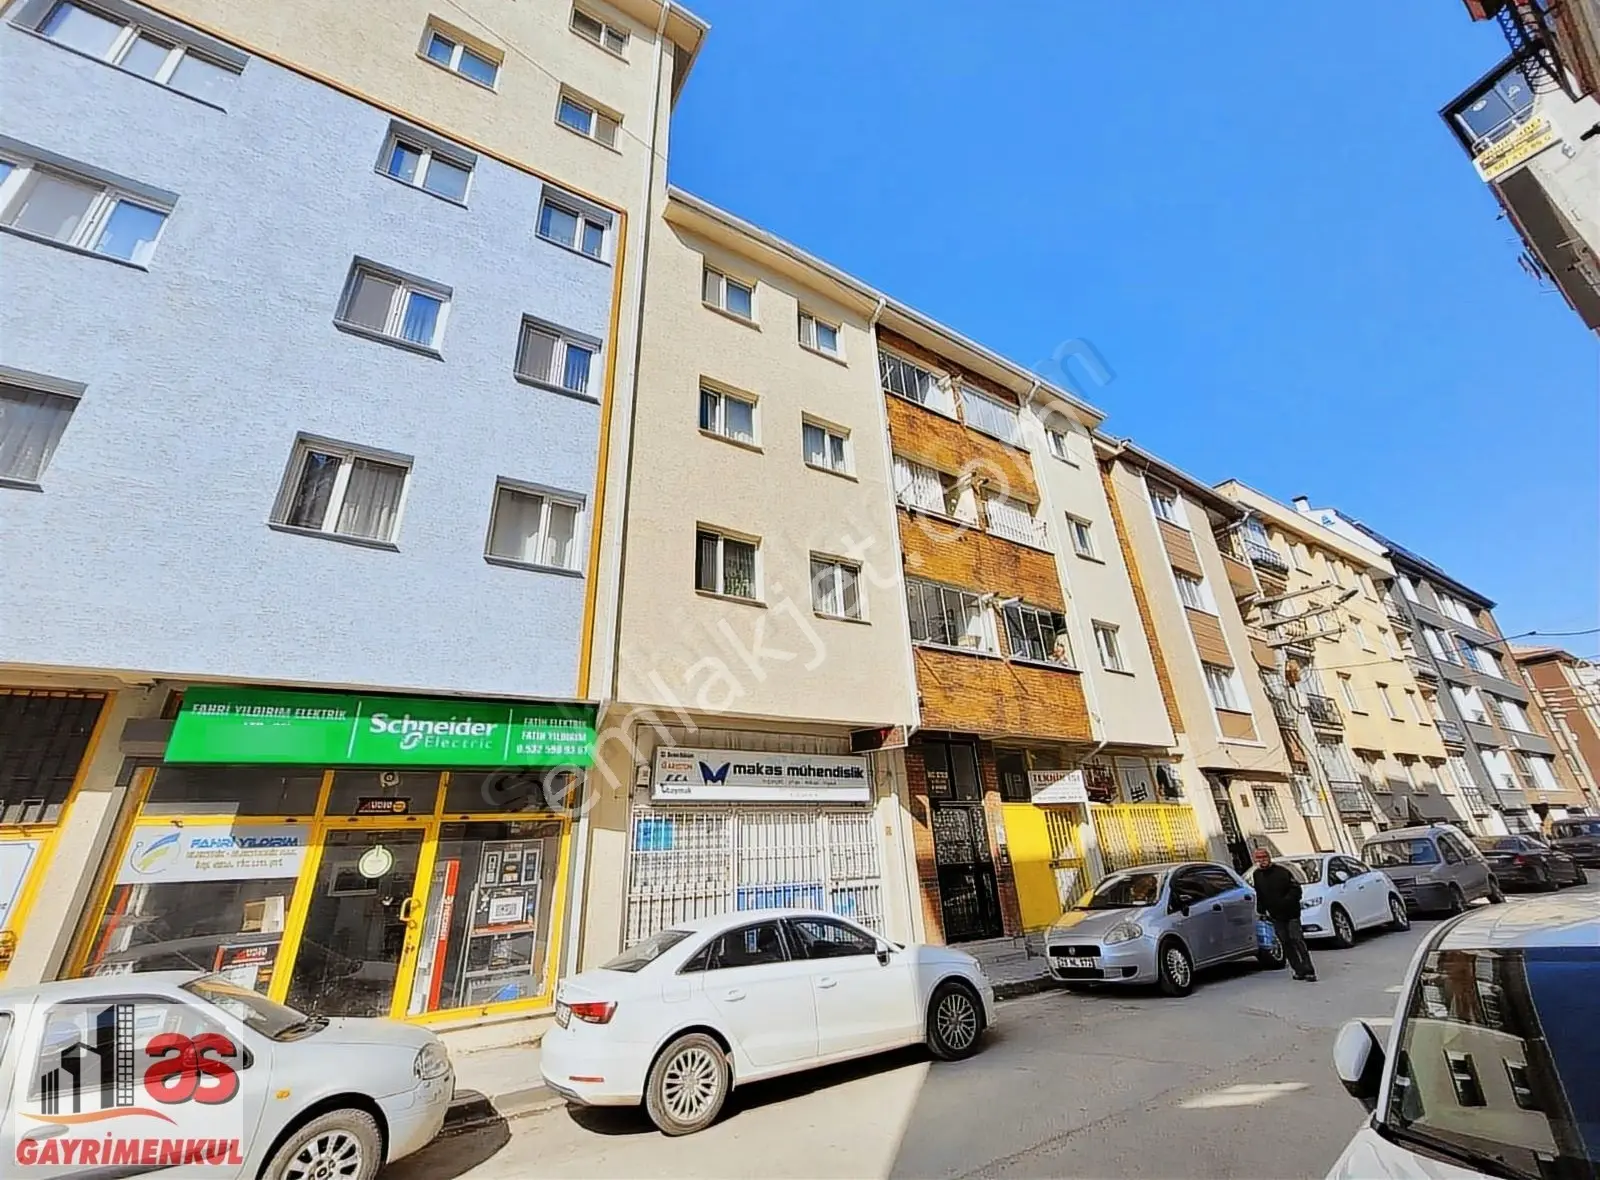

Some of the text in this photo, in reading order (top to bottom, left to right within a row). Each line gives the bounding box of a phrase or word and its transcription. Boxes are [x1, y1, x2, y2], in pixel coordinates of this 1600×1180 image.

[191, 702, 347, 720] FAHRİ YILDIRIM ELEKTRİK
[369, 712, 498, 749] Schneider Electric
[733, 763, 864, 779] makas mühendislik
